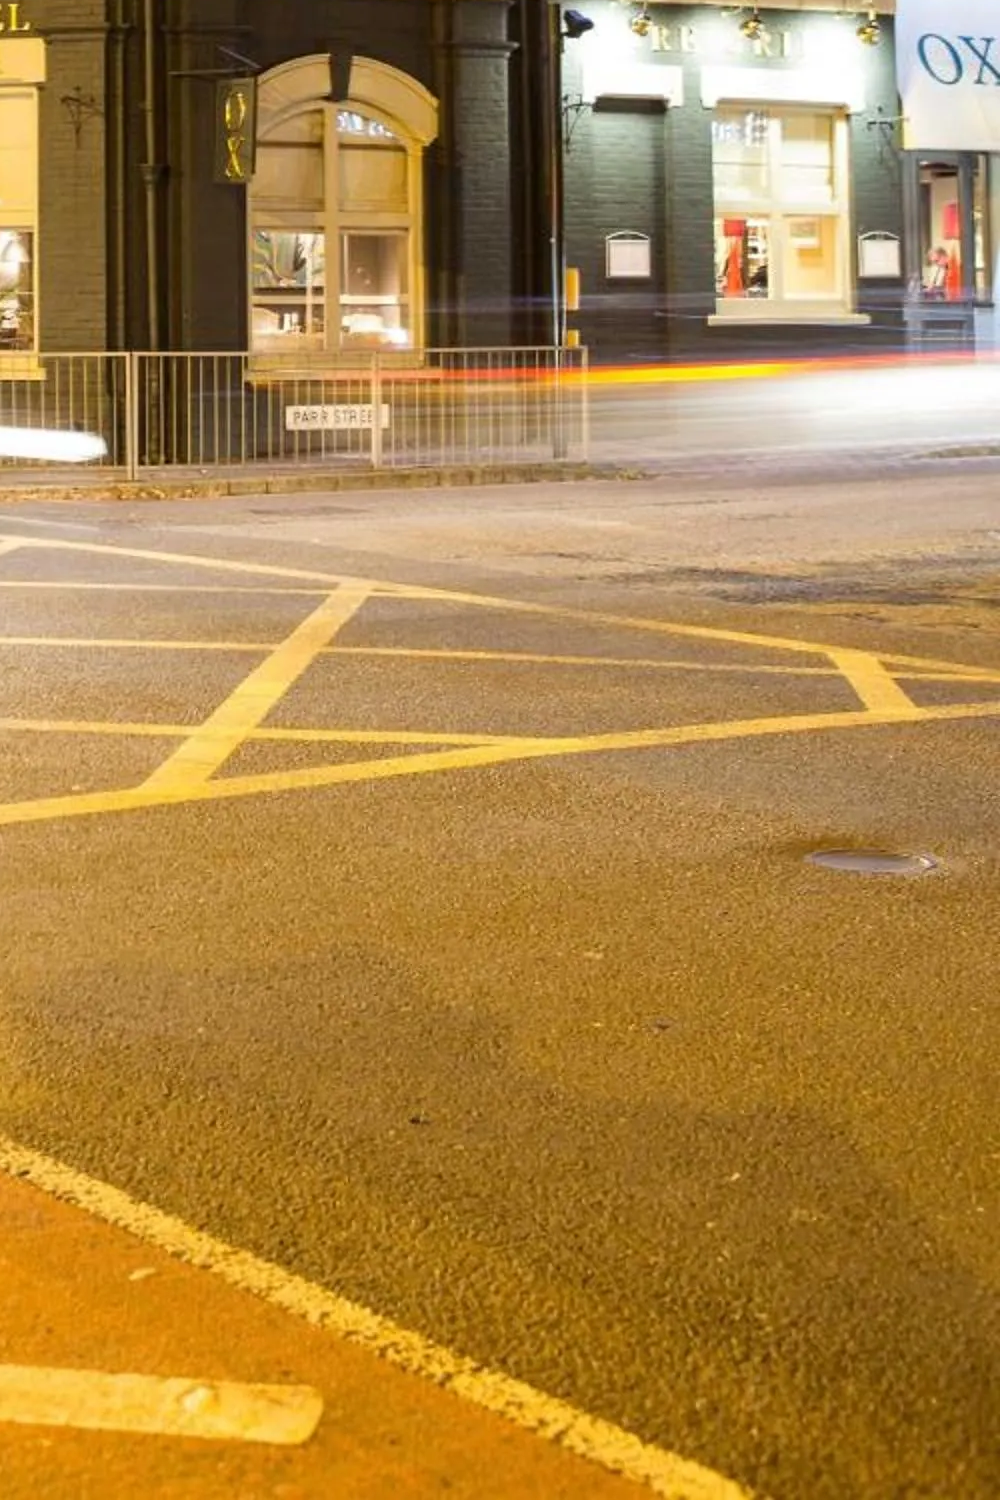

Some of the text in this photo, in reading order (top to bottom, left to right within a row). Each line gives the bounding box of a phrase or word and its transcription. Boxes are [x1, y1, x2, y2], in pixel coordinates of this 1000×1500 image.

[918, 33, 1000, 86] OX
[225, 92, 246, 177] OX
[293, 408, 374, 424] PARR STREE
